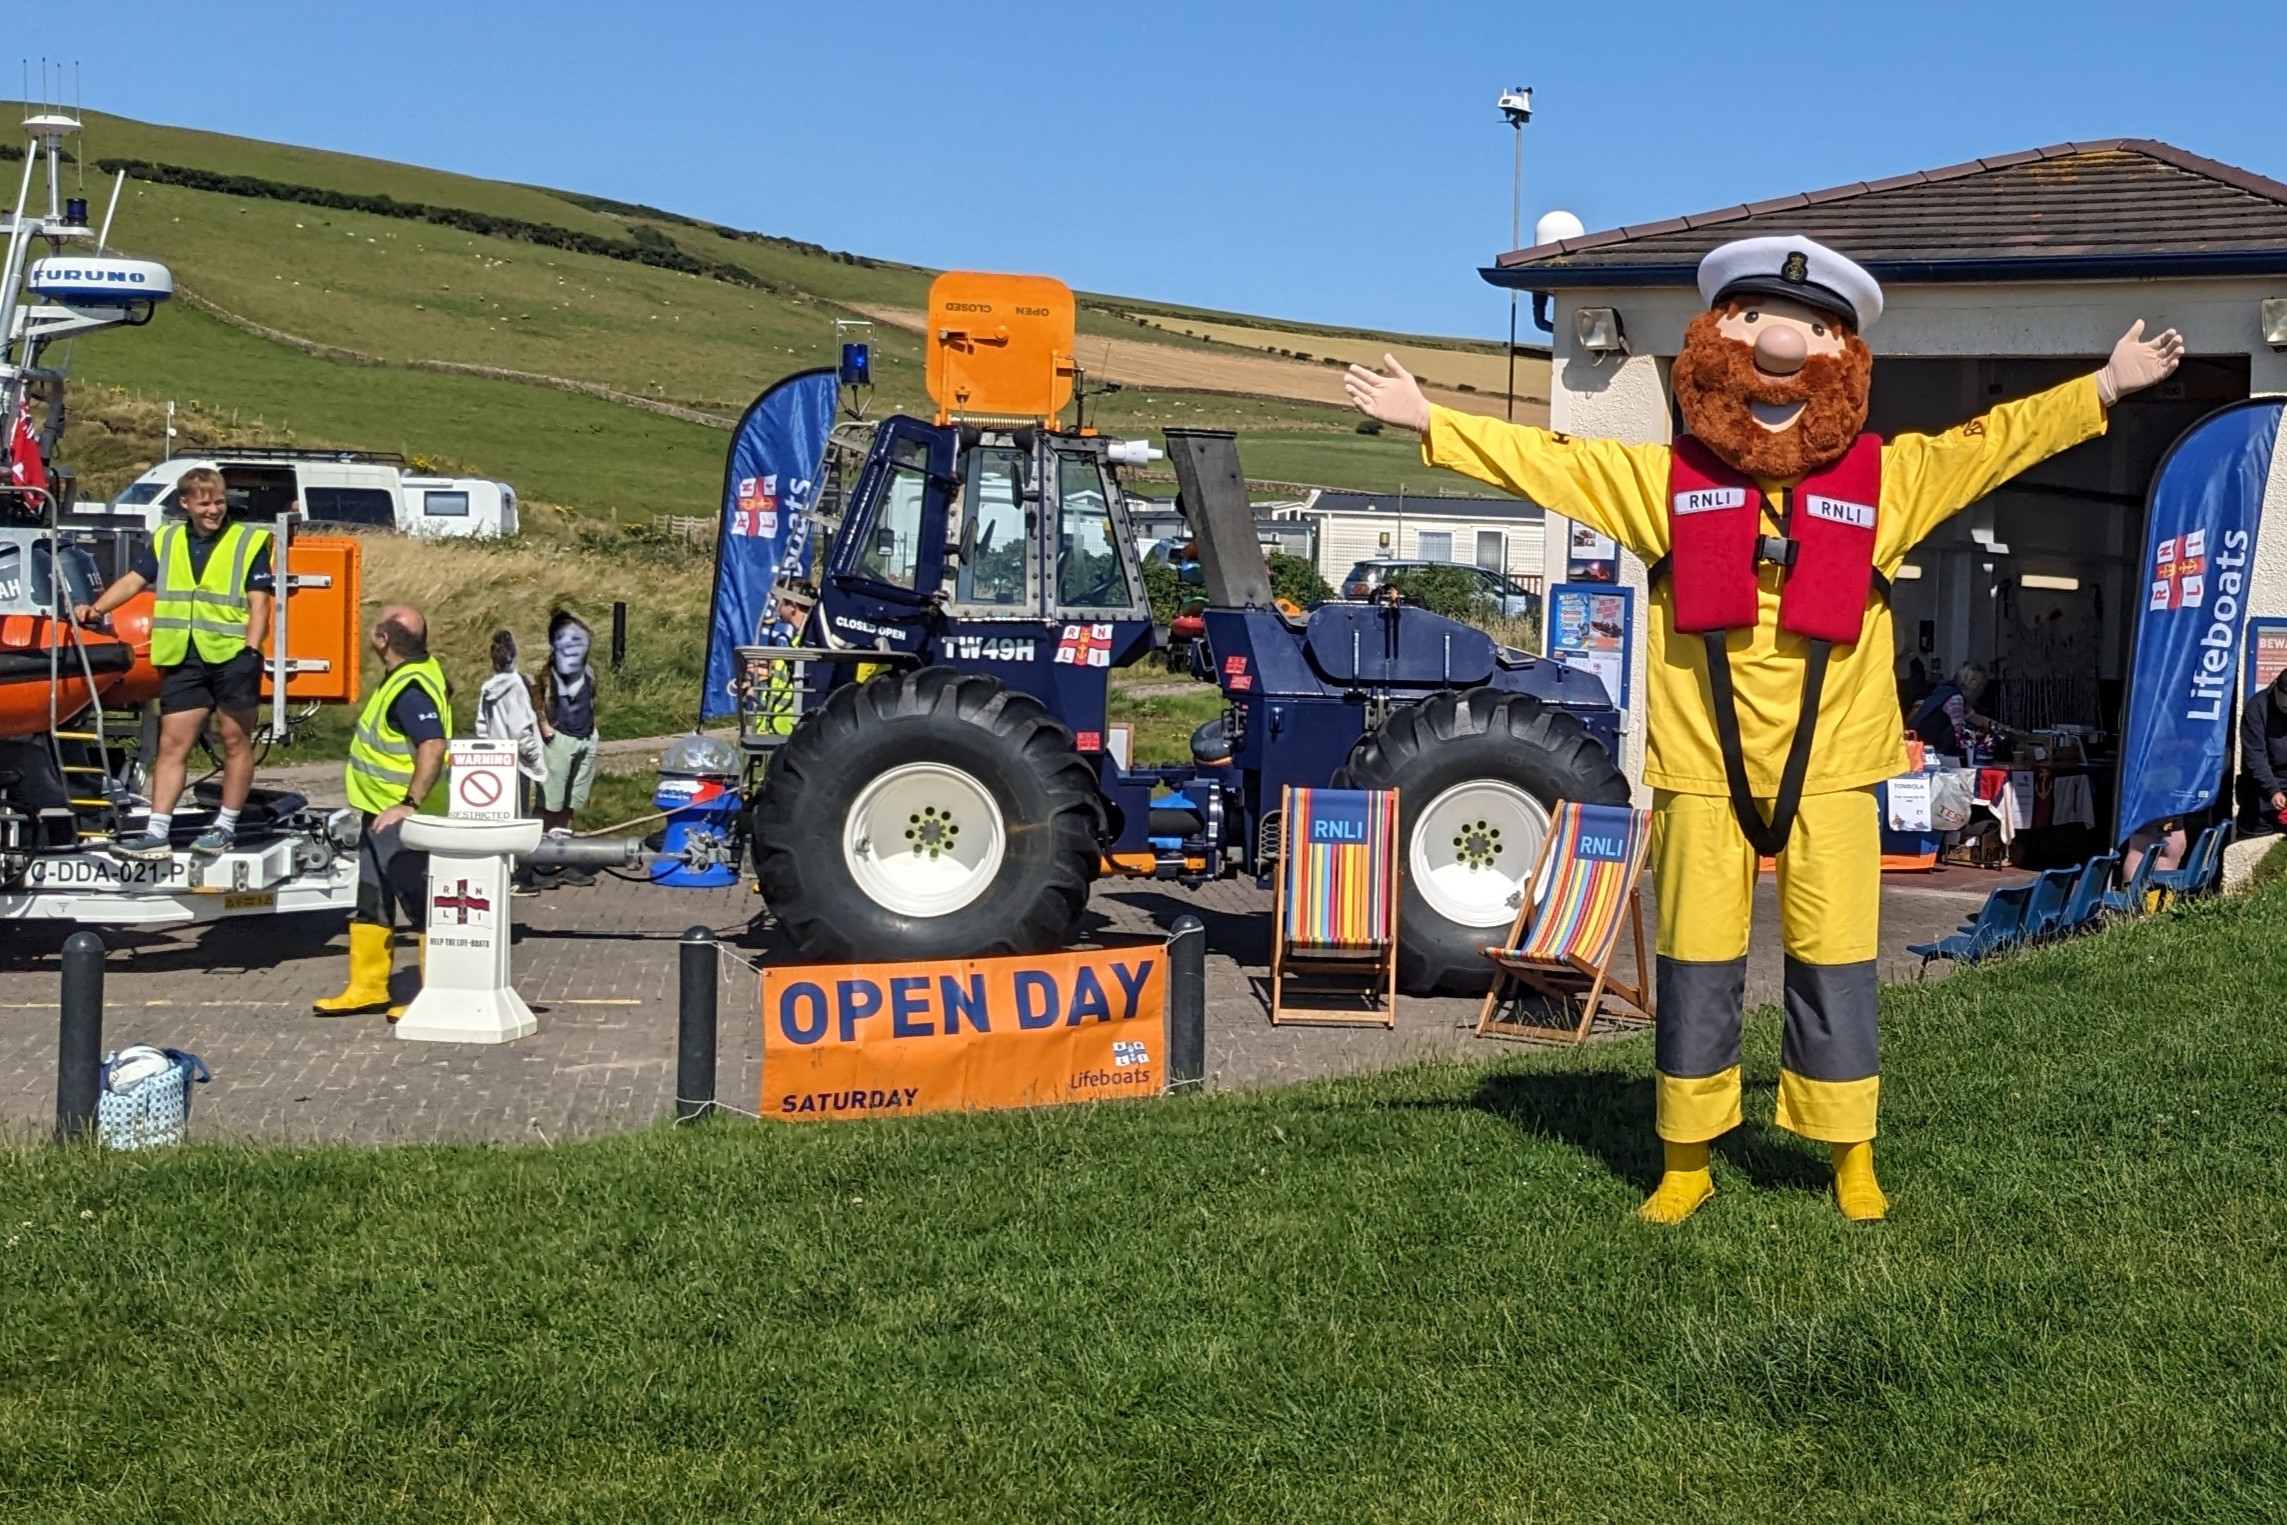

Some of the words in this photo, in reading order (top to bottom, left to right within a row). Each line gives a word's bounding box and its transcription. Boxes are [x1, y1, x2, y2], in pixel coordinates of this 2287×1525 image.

[33, 270, 145, 283] FURUNO
[945, 302, 992, 313] CLOSED
[1015, 306, 1050, 317] OPEN
[1689, 491, 1730, 508] RNLI
[1821, 501, 1861, 523] RNLI
[2159, 545, 2171, 557] N
[2154, 589, 2167, 601] R
[2186, 584, 2201, 596] L
[835, 616, 876, 633] CLOSED
[878, 626, 906, 640] OPEN
[1067, 628, 1076, 637] R
[1097, 628, 1106, 637] N
[2186, 530, 2248, 721] Lifeboats
[941, 636, 1035, 661] TW49H
[2260, 638, 2287, 649] BEW
[1062, 649, 1070, 660] L
[454, 754, 512, 766] WARNING
[449, 810, 511, 820] RESTRICTED
[1315, 820, 1363, 839] RNLI
[1580, 836, 1623, 857] RNLI
[31, 861, 185, 883] C-DDA-021-P
[443, 885, 450, 894] R
[475, 887, 482, 896] N
[443, 910, 450, 918] L
[779, 972, 990, 1045] OPEN
[1013, 960, 1155, 1030] DAY
[1071, 1068, 1150, 1089] Lifeboats
[782, 1088, 919, 1113] SATURDAY
